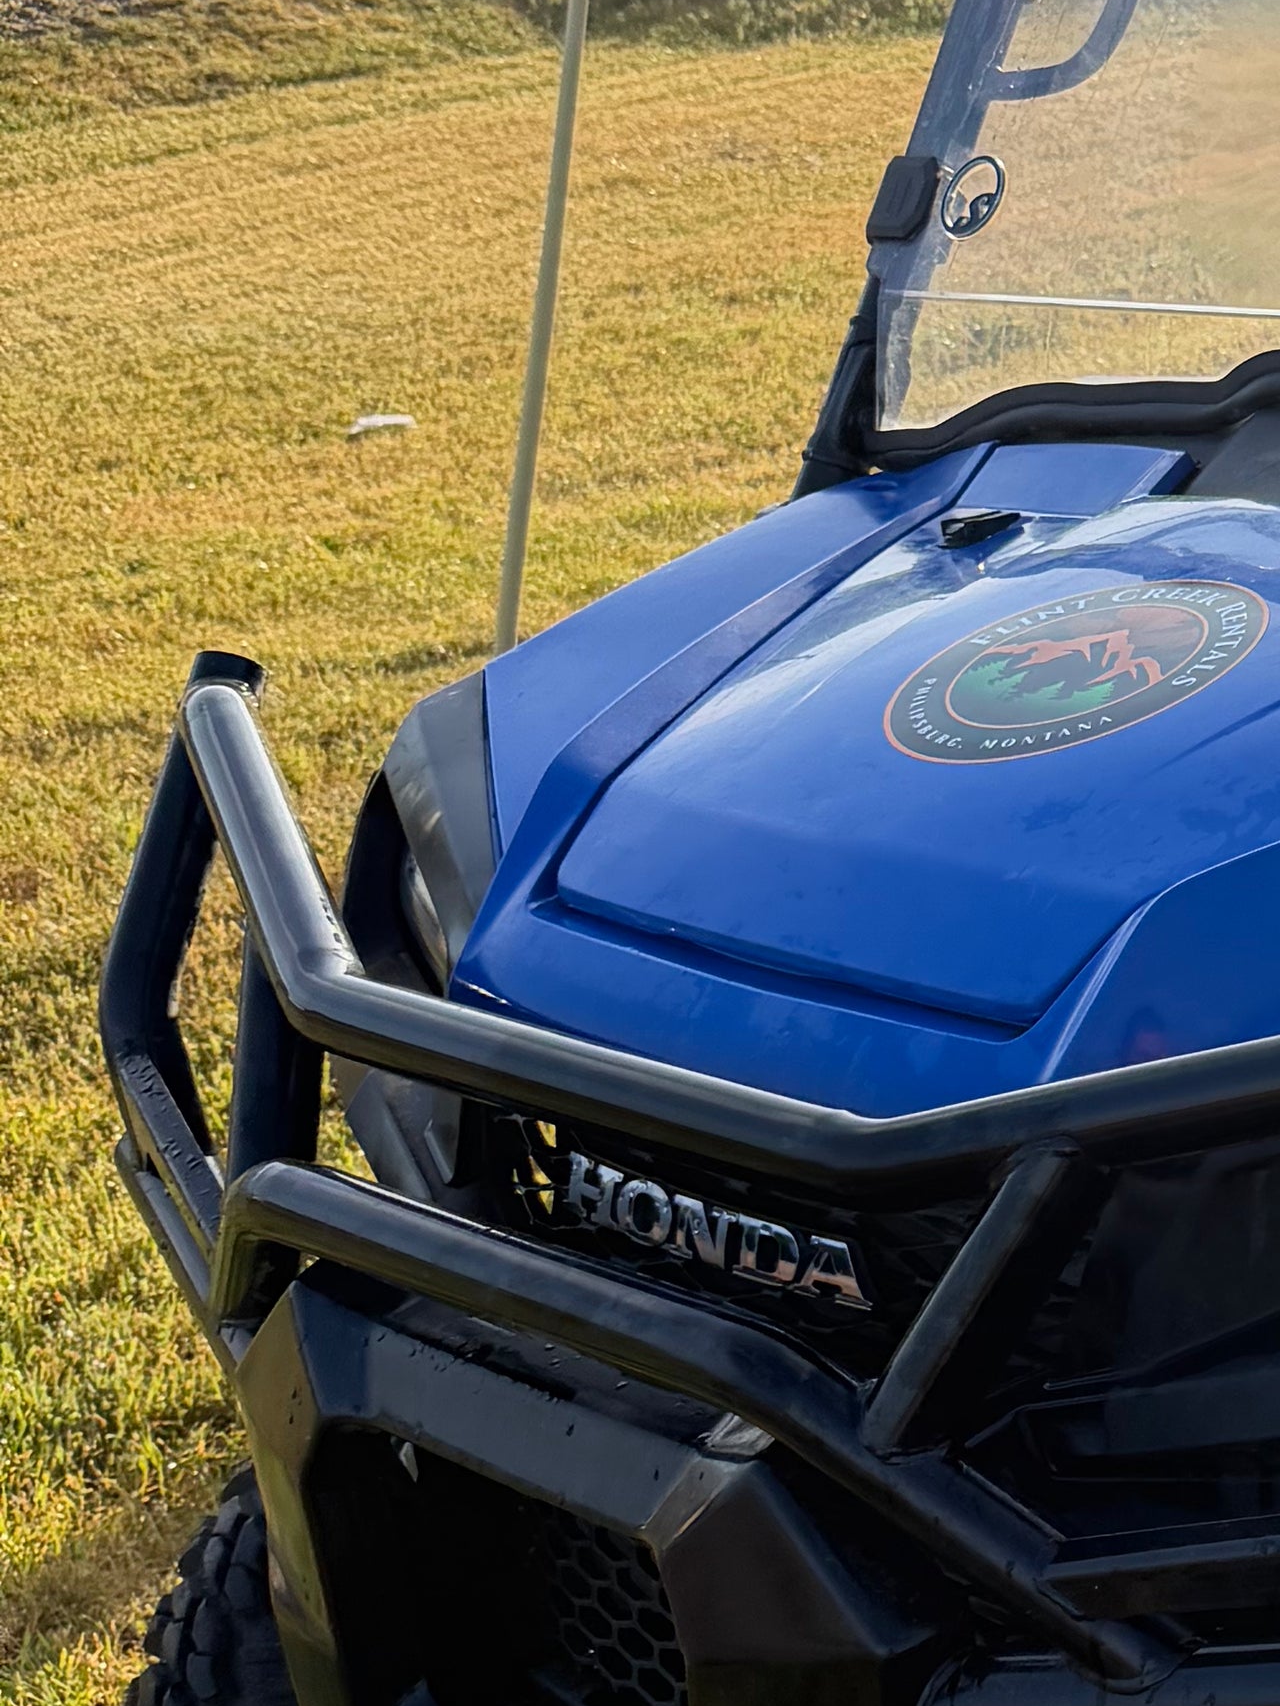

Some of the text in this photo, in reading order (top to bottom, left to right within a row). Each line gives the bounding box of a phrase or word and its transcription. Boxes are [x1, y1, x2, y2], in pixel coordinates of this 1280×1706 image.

[969, 587, 1248, 688] FLINT CREEK RENTALS
[979, 716, 1112, 750] MONTANA
[563, 1150, 874, 1311] HONDA
